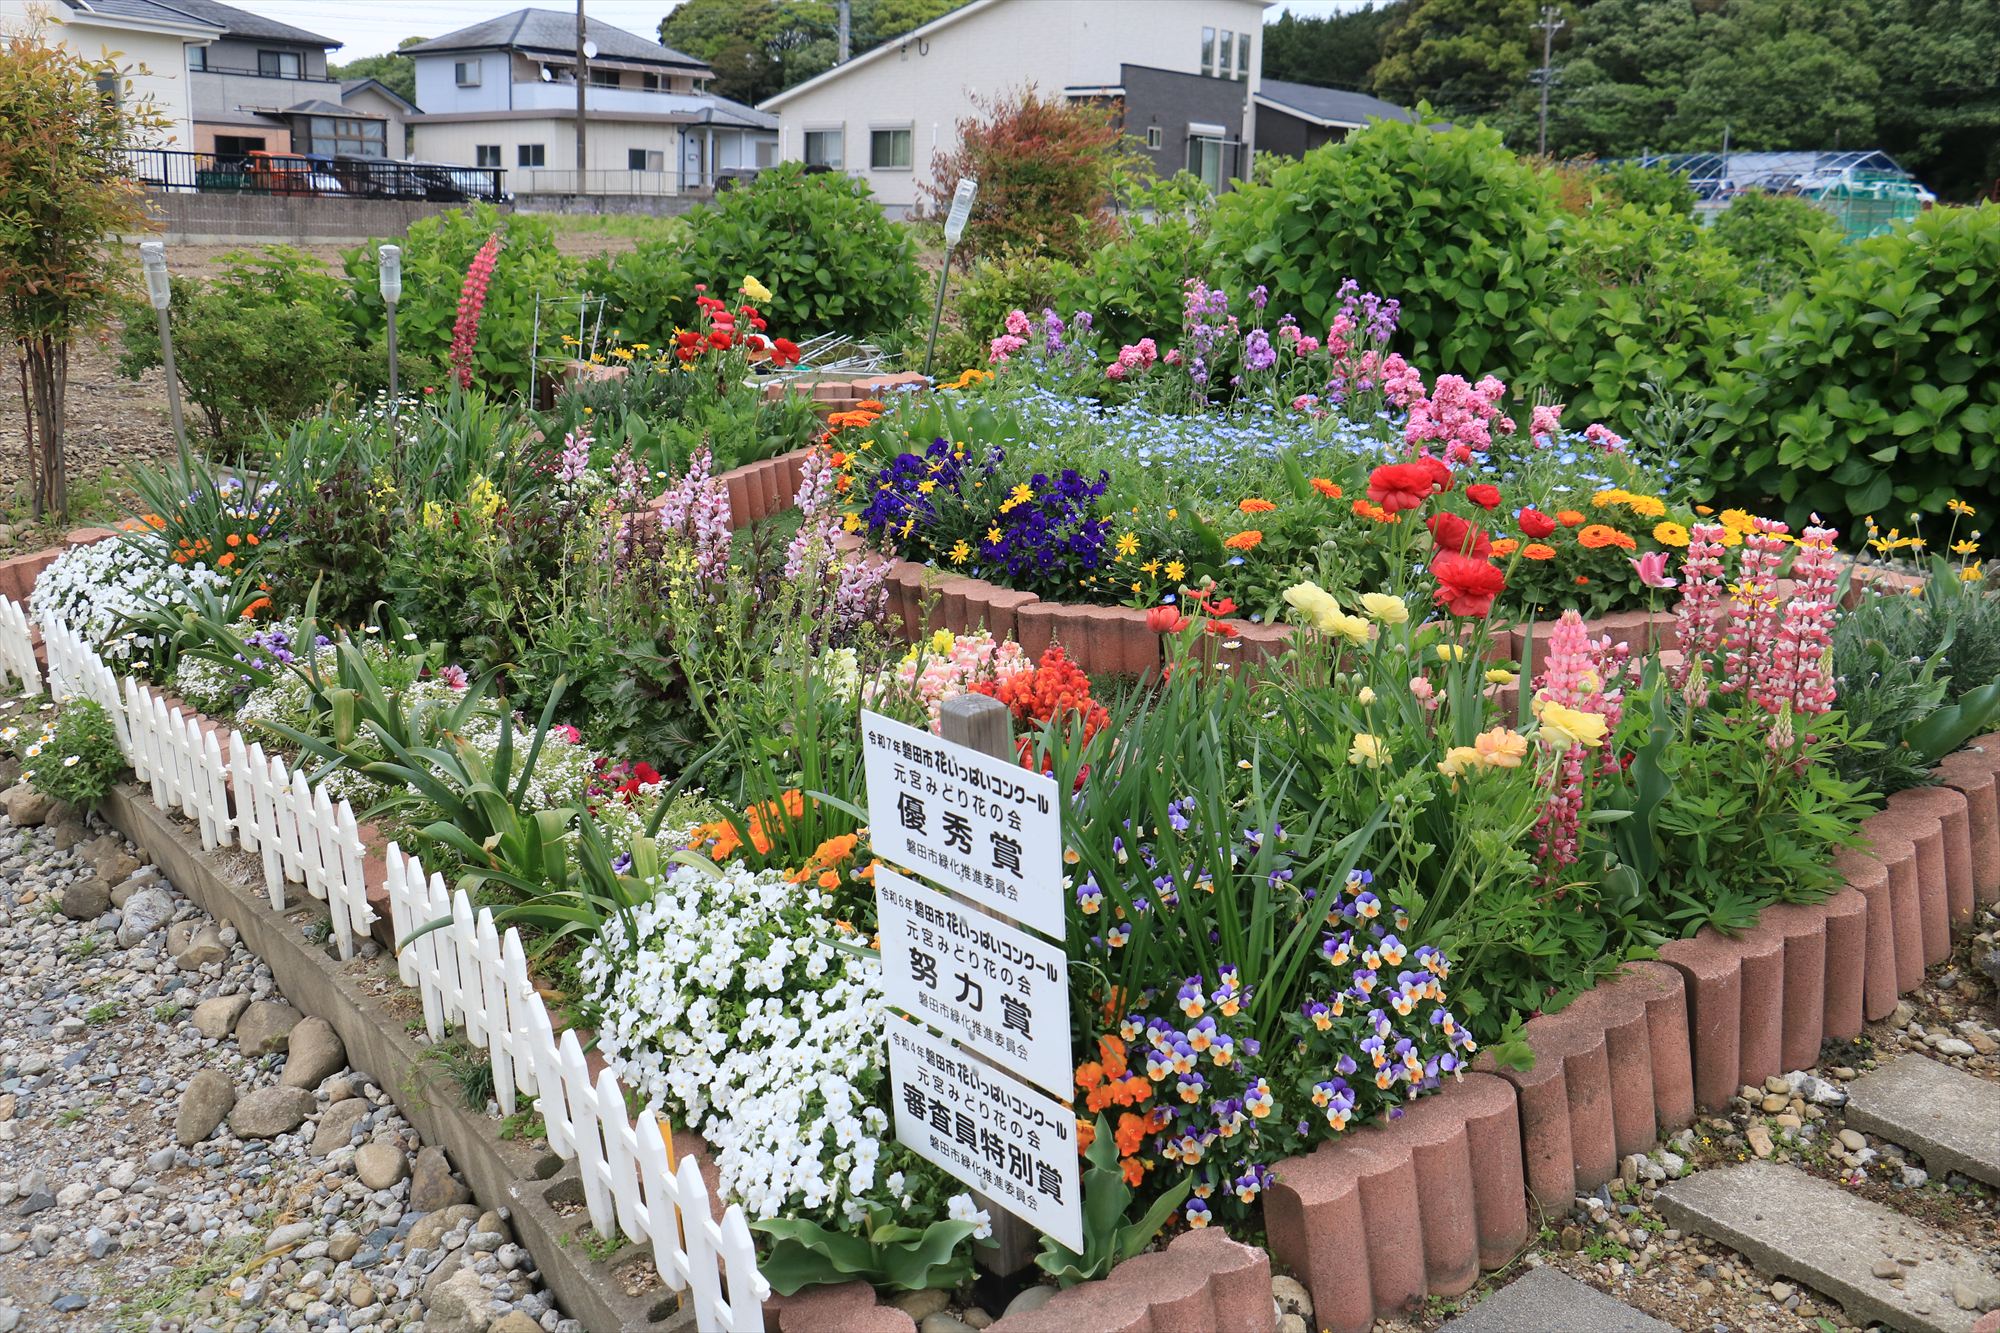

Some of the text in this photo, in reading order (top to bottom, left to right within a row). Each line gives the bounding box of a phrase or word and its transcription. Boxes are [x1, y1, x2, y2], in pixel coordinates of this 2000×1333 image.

[868, 731, 1049, 815] 令和7年磐田市花いっぱいコンクール
[893, 762, 1022, 832] 元宮みどり花の会
[897, 791, 1024, 880] 優秀賞
[906, 838, 1018, 902] 磐田市緑化推進委員会
[881, 887, 1057, 982] 令和6年磐田市花いっぱいコンクール
[906, 919, 1032, 997] 元宮みどり花の会
[909, 947, 1033, 1041] 努力賞
[918, 991, 1028, 1062] 磐田市緑化推進委員会
[892, 1032, 1067, 1140] 令和4年磐田市花いっぱいコンクール
[917, 1066, 1041, 1151] 元宮みどり花の会
[903, 1082, 1064, 1206] 審査員特別賞
[929, 1134, 1038, 1211] 磐田市緑化推進委員会
